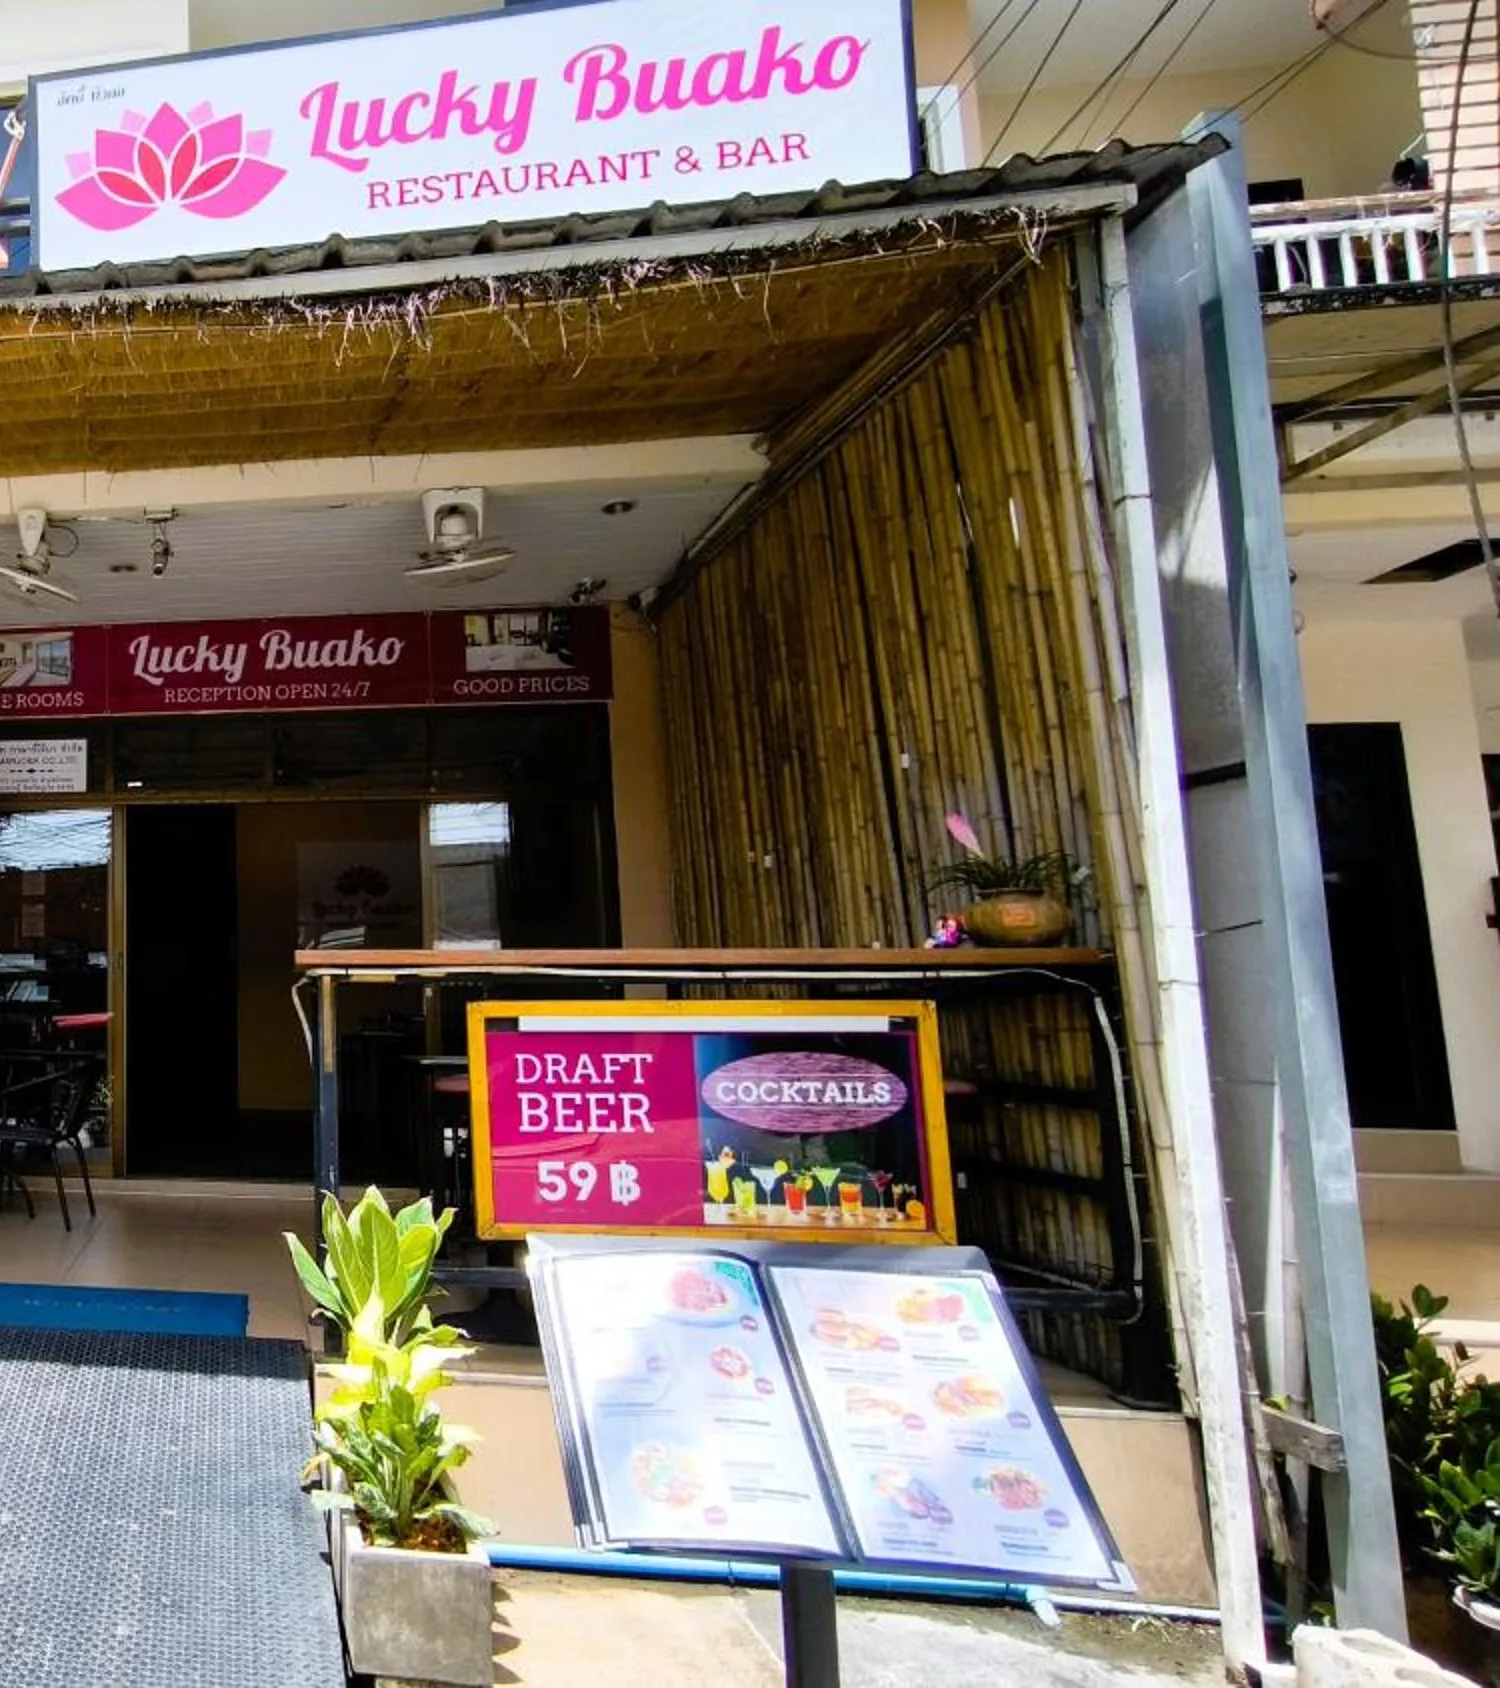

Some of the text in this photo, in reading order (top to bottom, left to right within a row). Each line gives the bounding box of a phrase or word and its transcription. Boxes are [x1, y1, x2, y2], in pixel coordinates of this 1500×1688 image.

[300, 25, 873, 173] Lucky Buako
[366, 131, 811, 210] RESTAURANT & BAR
[129, 628, 406, 686] Lucky Buako
[15, 691, 86, 709] ROOMS
[164, 680, 371, 704] RECEPTION OPEN 24/7
[452, 675, 591, 696] GOOD PRICES
[515, 1053, 653, 1085] DRAFT
[714, 1080, 893, 1106] COCKTAILS
[517, 1092, 655, 1134] BEER
[537, 1161, 598, 1202] 59
